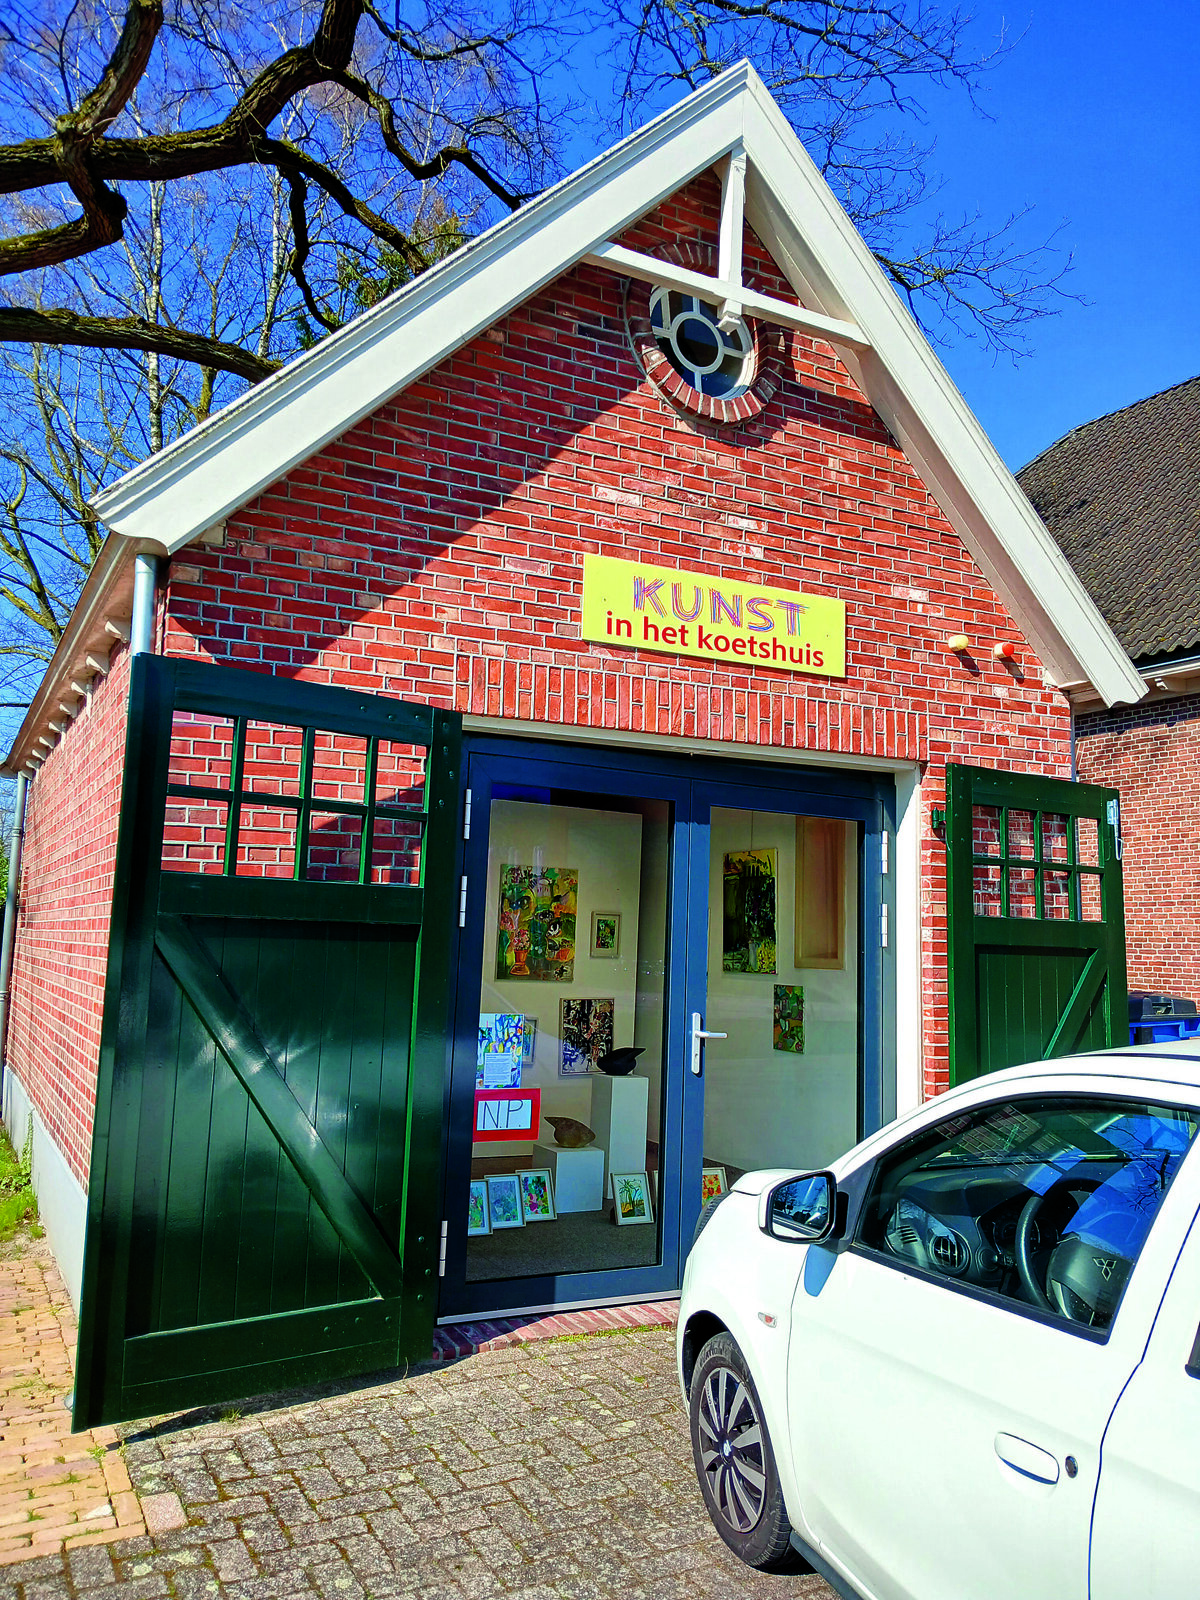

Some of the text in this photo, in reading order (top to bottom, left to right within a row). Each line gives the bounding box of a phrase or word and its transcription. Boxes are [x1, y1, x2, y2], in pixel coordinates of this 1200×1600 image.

[633, 576, 809, 636] KUNST
[606, 611, 824, 667] in het koetshuis
